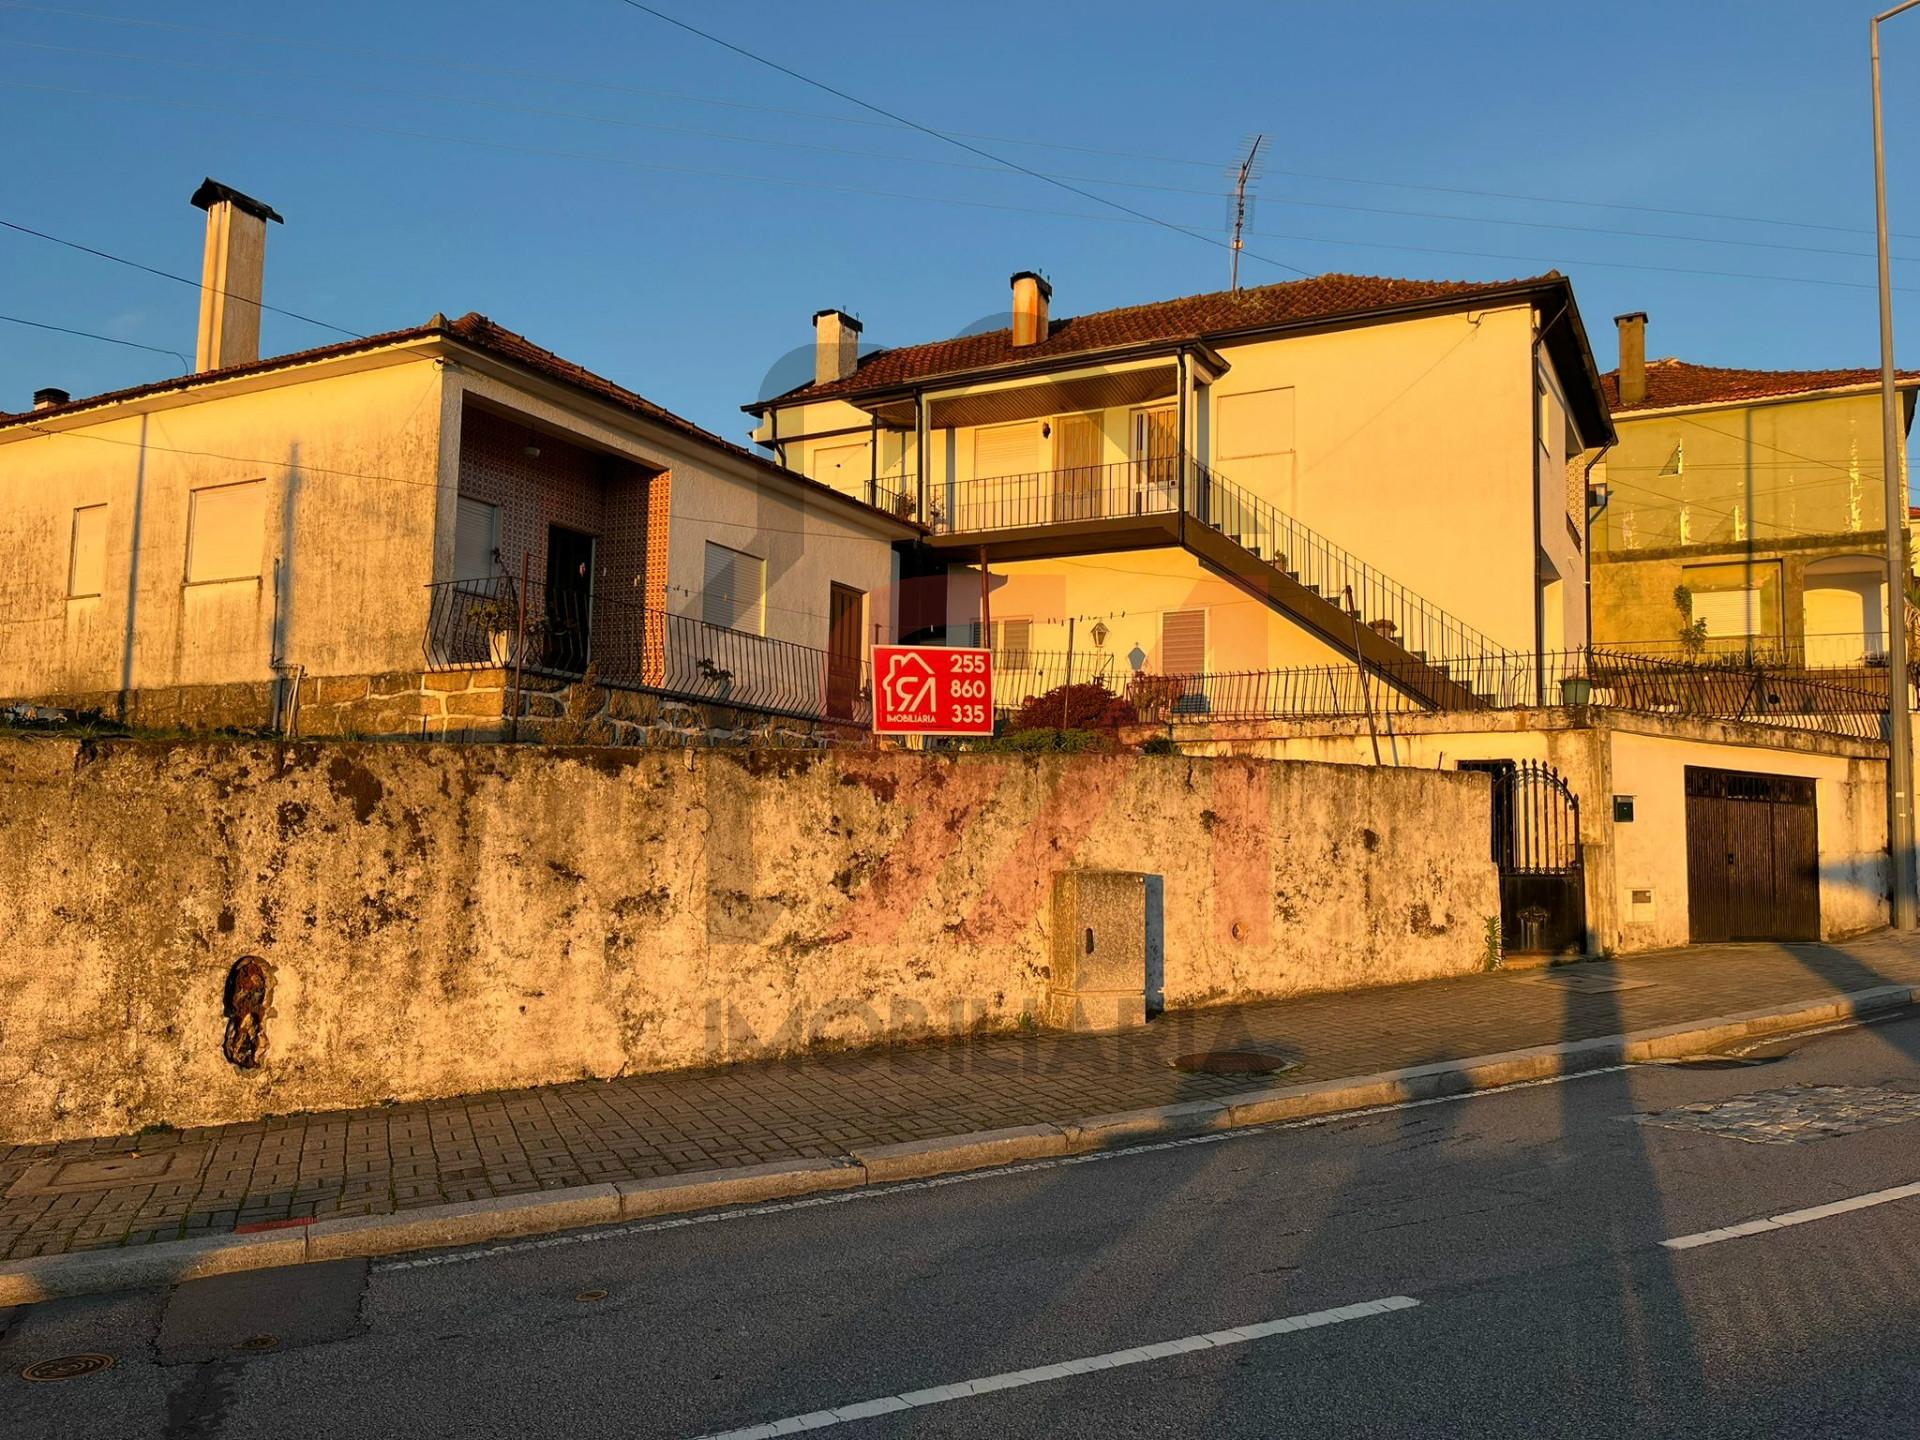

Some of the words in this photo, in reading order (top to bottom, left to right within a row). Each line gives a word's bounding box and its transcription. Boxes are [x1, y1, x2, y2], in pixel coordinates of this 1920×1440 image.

[950, 654, 986, 673] 255
[950, 679, 986, 698] 860
[951, 704, 985, 723] 335
